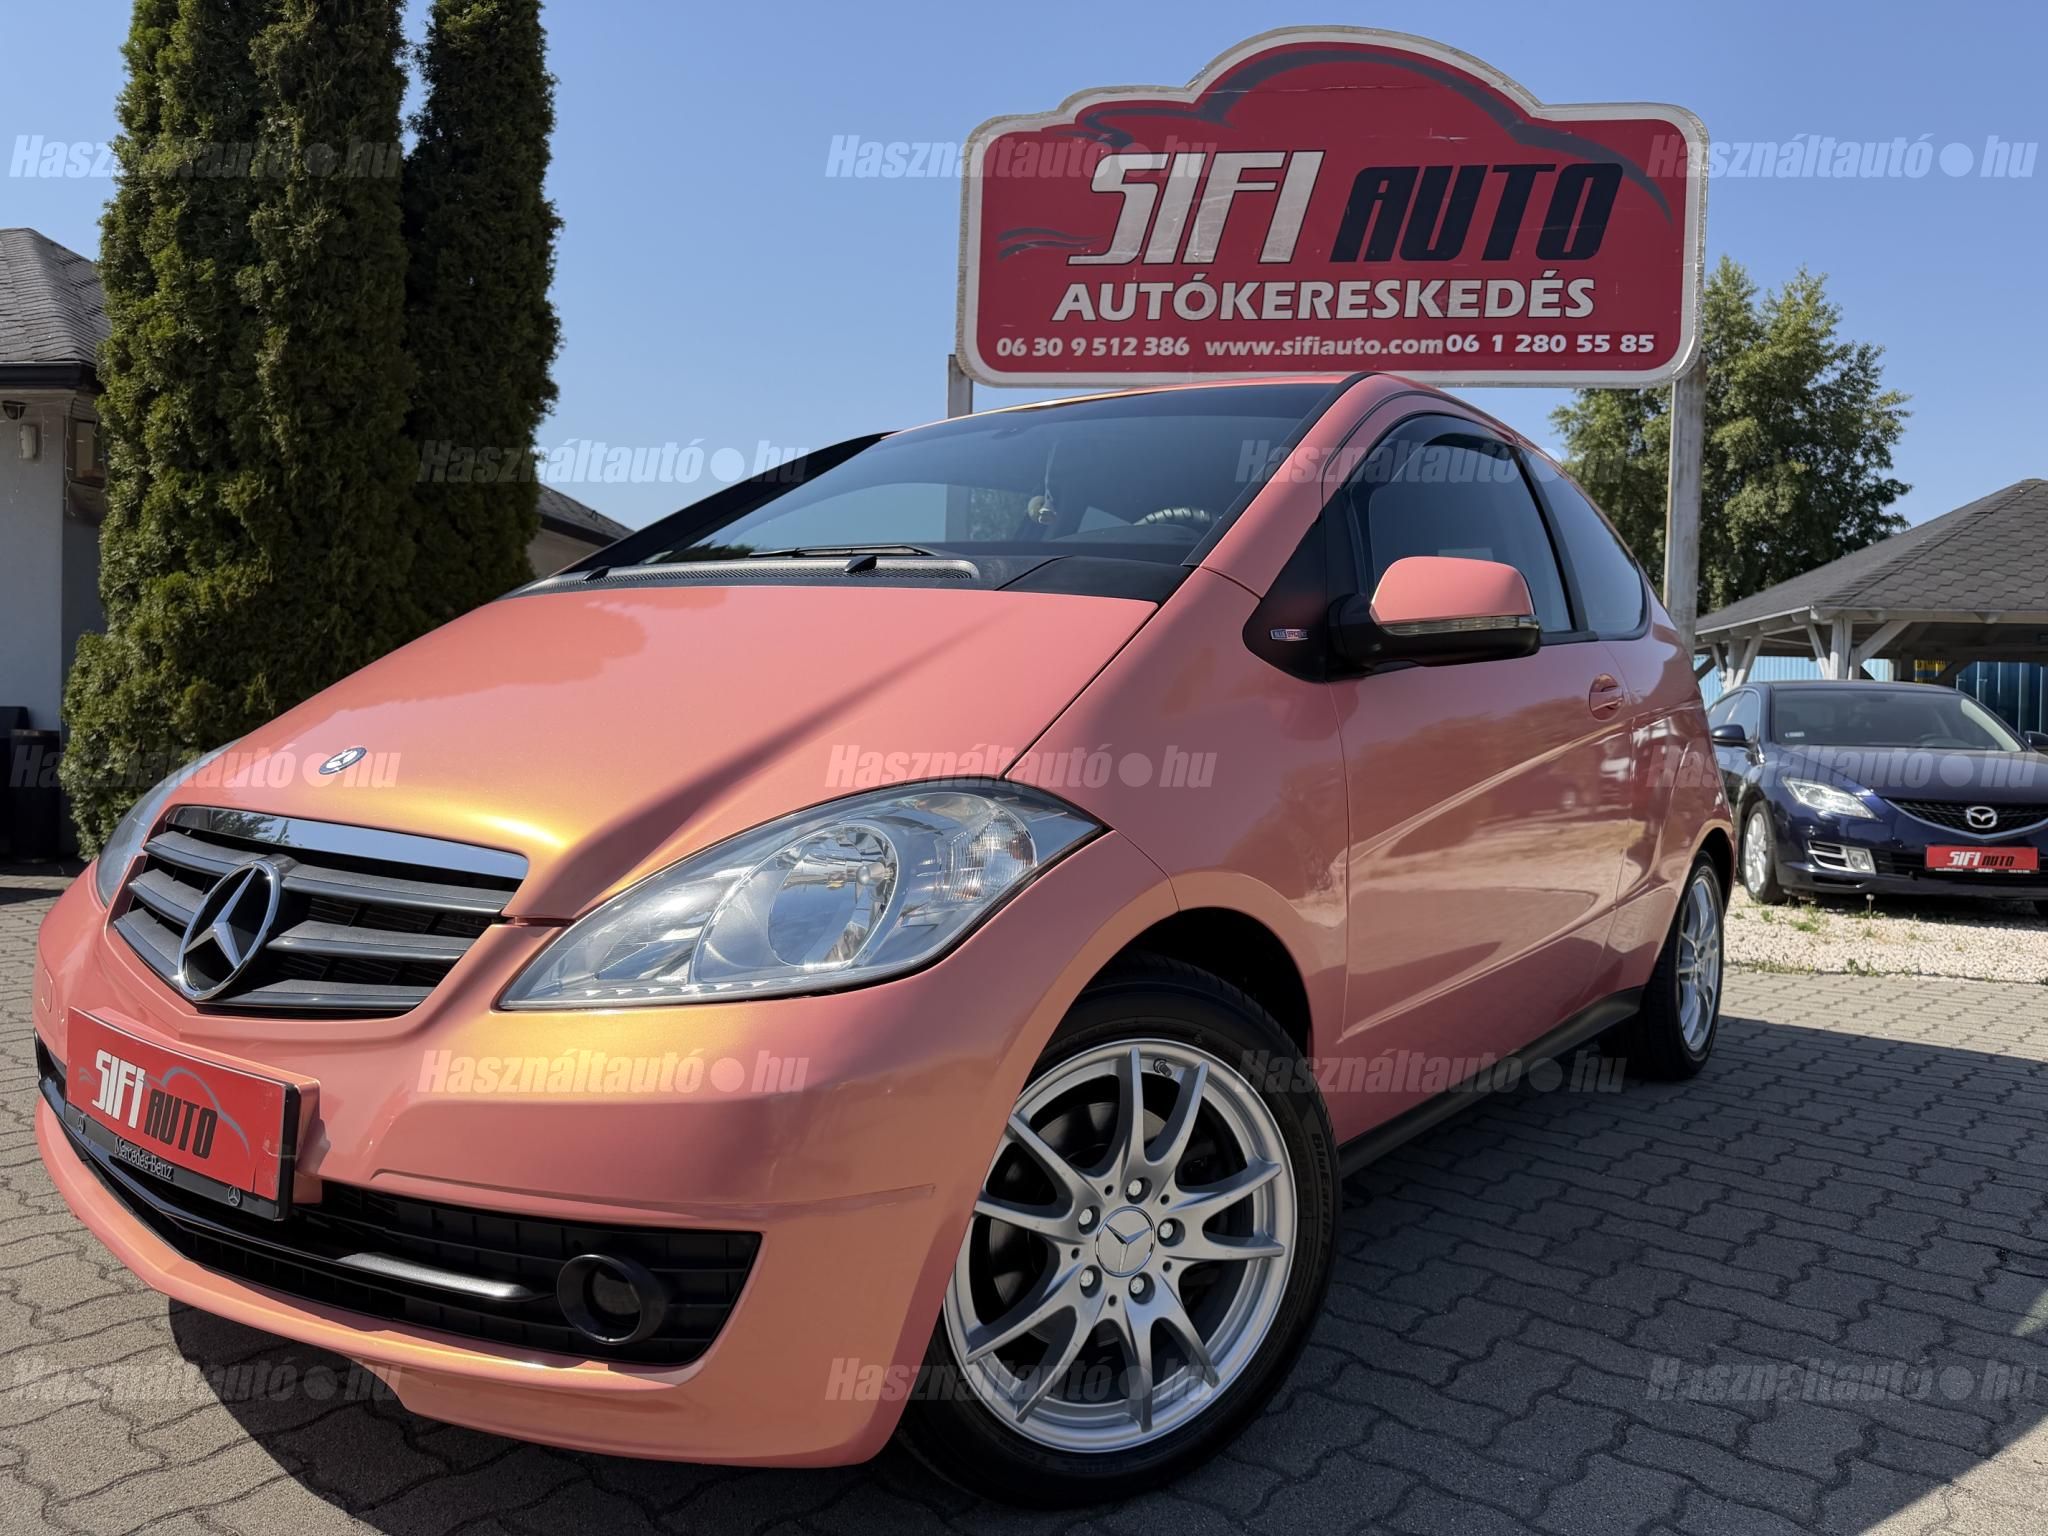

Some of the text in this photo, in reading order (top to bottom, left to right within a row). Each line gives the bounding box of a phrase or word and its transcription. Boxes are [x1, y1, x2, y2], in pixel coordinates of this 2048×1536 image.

[1066, 149, 1625, 265] SIFI AUTO
[1052, 268, 1595, 322] AUTÓKERESKEDÉS
[996, 338, 1027, 356] 06
[1032, 338, 1063, 356] 30
[1092, 338, 1137, 356] 512
[1143, 337, 1190, 356] 386
[1205, 337, 1443, 355] www.sifiauto.com
[1446, 334, 1480, 353] 06
[1491, 334, 1503, 353] 1
[1514, 334, 1567, 353] 280
[1576, 335, 1610, 353] 55
[1619, 335, 1654, 353] 85
[1946, 851, 1981, 866] SIFI
[92, 1049, 218, 1160] SIFI AUTO
